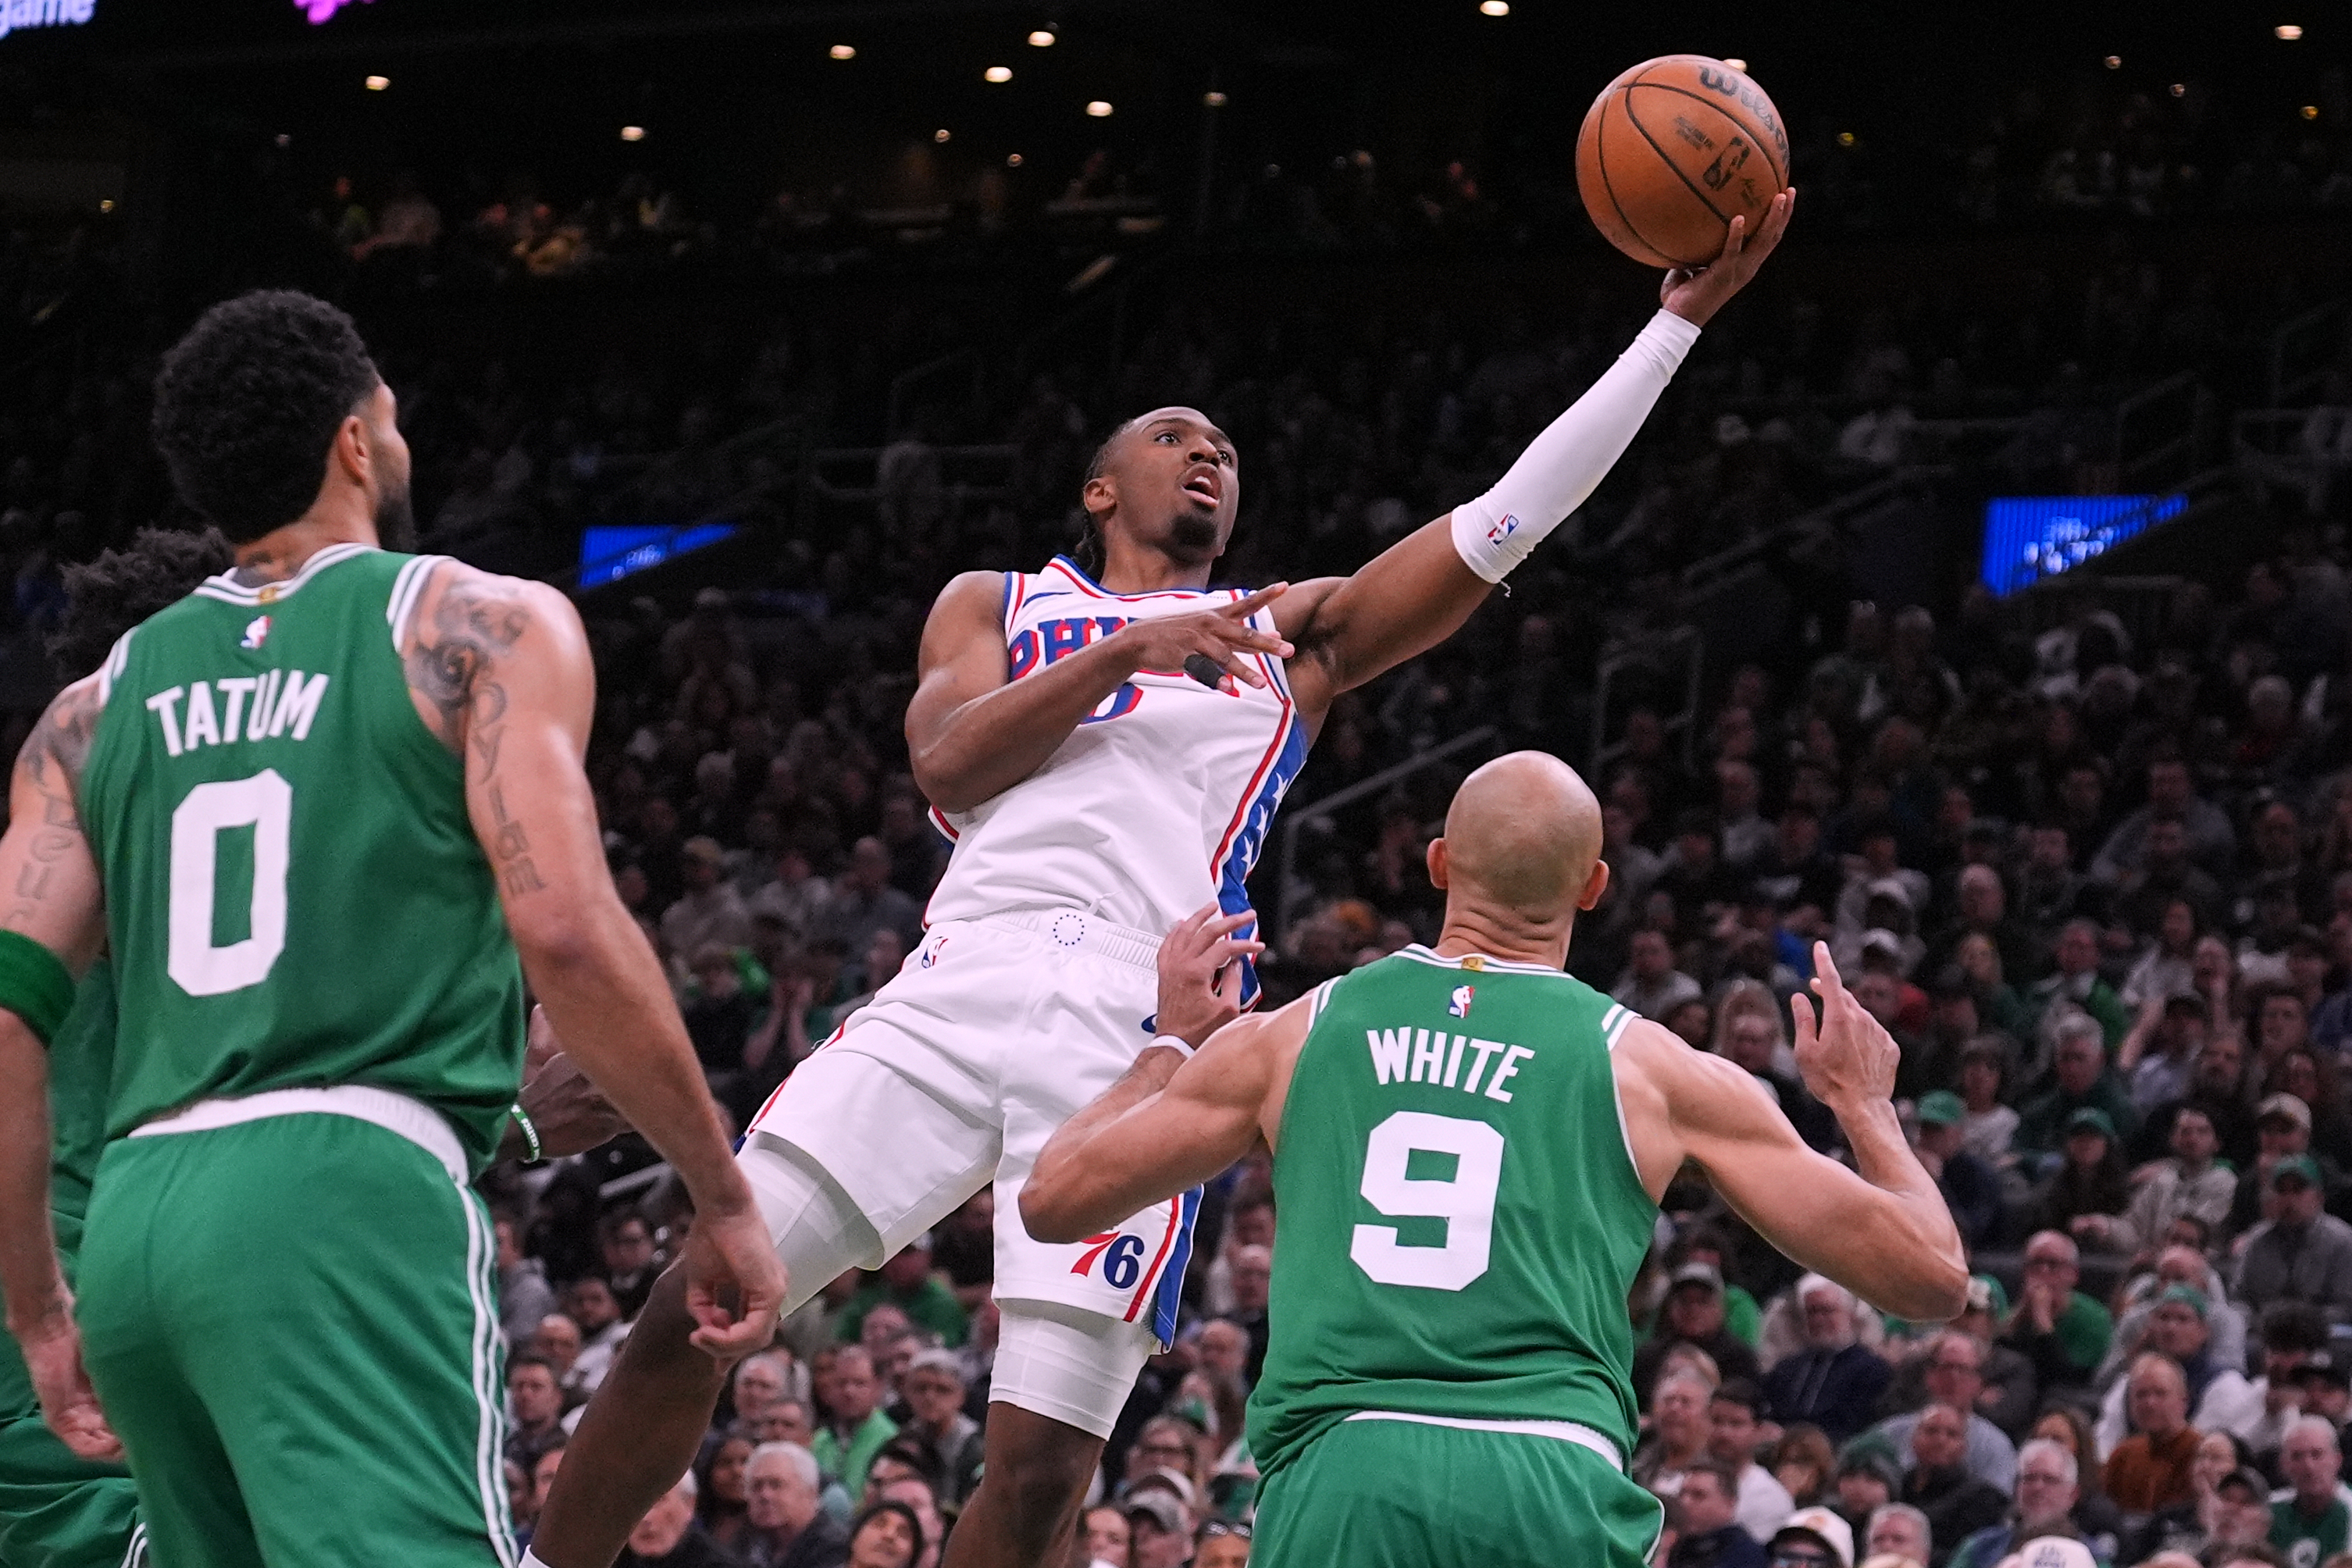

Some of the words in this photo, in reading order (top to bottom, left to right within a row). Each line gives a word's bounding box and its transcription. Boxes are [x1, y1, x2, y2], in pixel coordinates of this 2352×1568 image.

[1698, 64, 1791, 177] Wilson
[145, 668, 330, 757] TATUM
[168, 768, 293, 996] 0
[1367, 1026, 1536, 1103] WHITE
[1350, 1110, 1505, 1292] 9
[1070, 1231, 1145, 1289] 76
